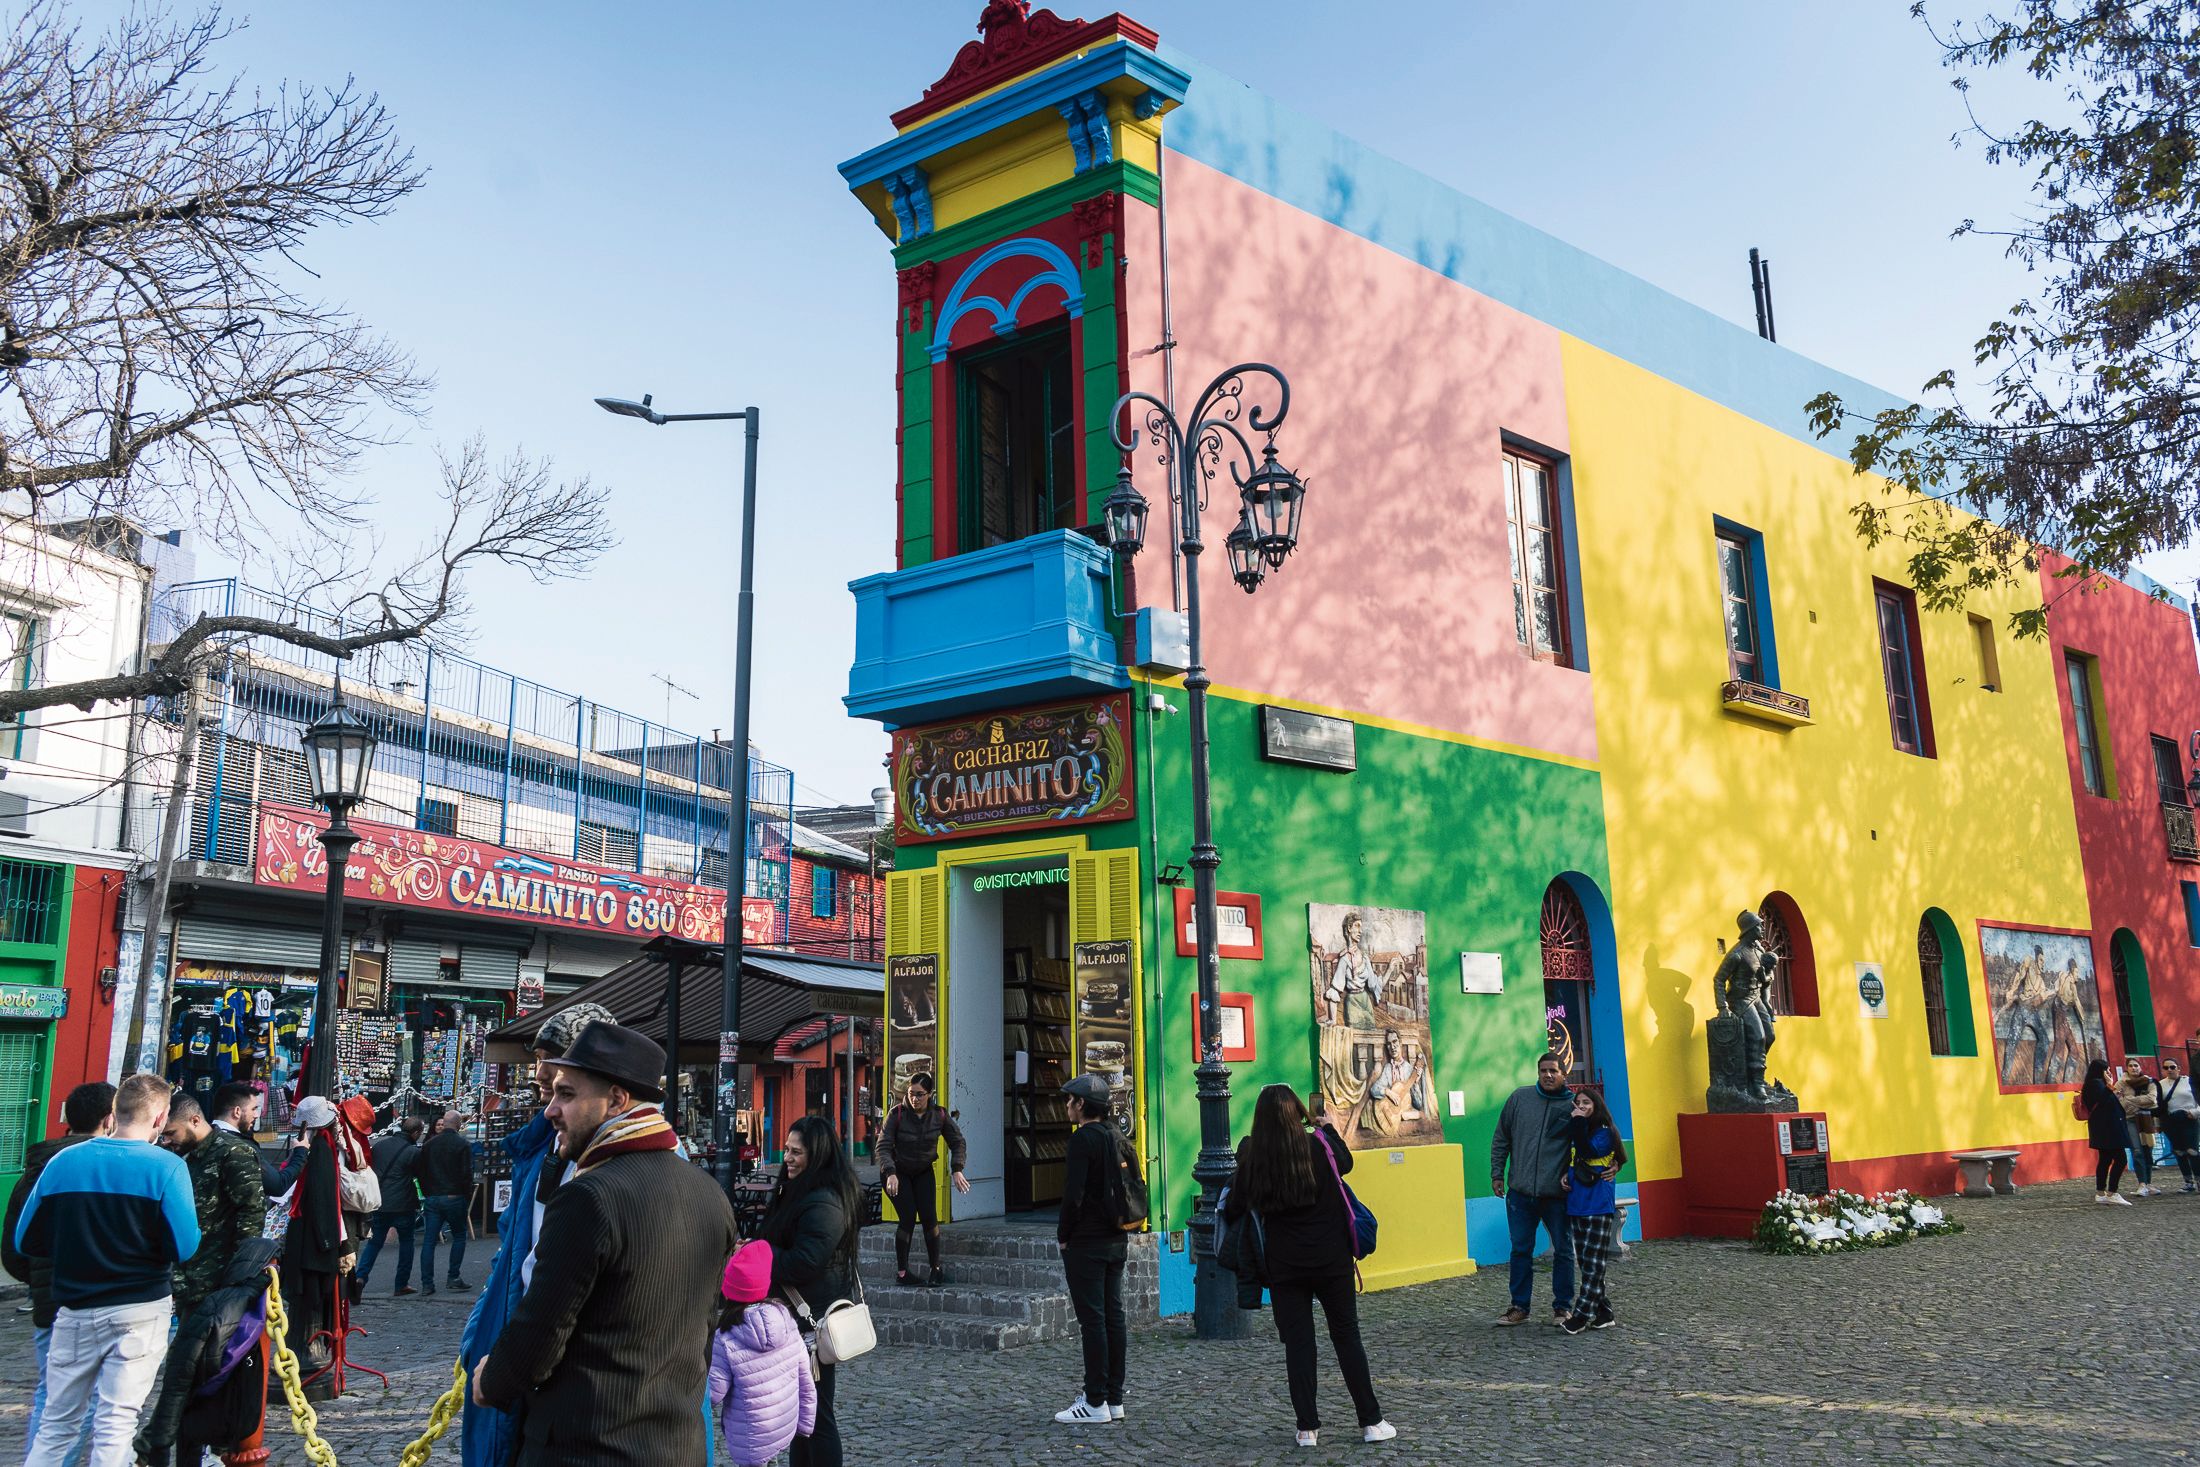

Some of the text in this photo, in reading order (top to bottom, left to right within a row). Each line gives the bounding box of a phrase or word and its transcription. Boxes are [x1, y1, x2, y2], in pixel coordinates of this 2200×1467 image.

[931, 755, 1082, 815] CAMINITO
[963, 805, 1041, 823] BUENOS AIRES
[345, 864, 366, 880] oca
[557, 864, 598, 884] PASEO
[451, 865, 618, 924] CAMINITO
[626, 896, 676, 933] 830
[1081, 953, 1126, 965] ALFAJOR
[894, 965, 934, 977] ALFAJOR
[39, 992, 58, 1003] BAR
[260, 998, 269, 1011] 10
[2, 1007, 43, 1017] TAKE AWAY
